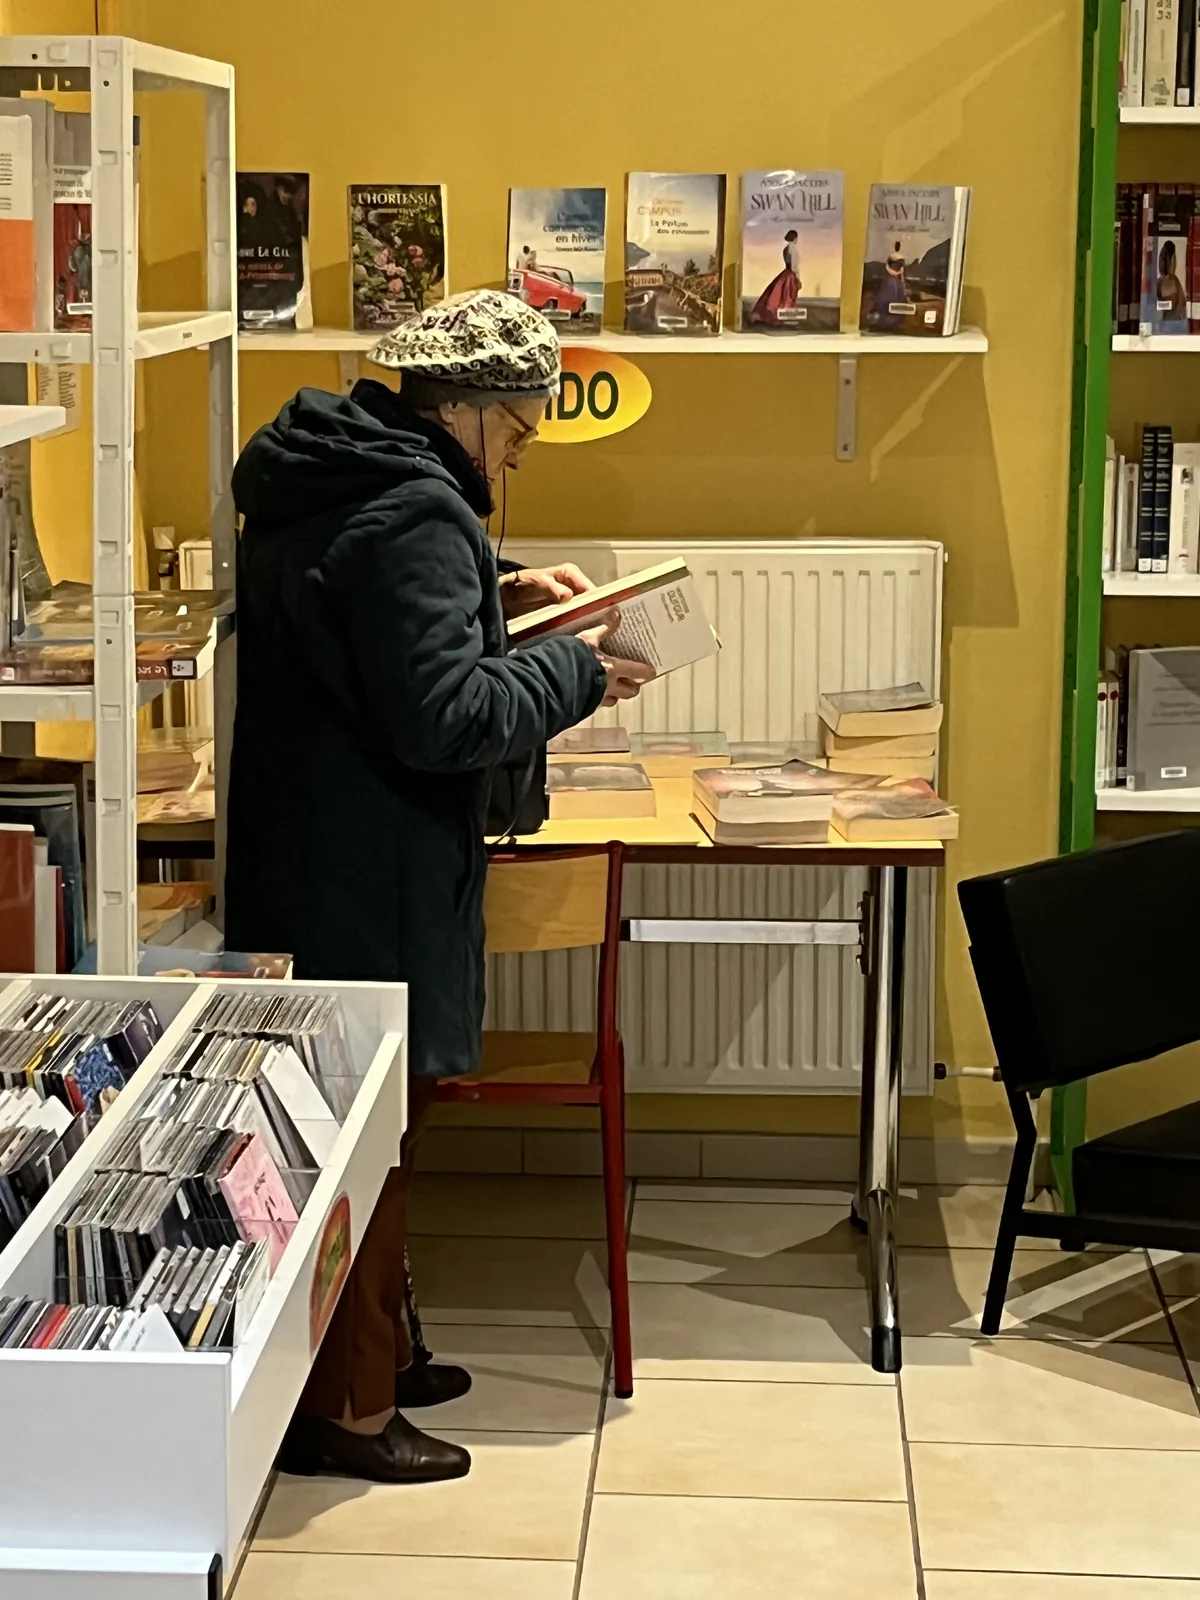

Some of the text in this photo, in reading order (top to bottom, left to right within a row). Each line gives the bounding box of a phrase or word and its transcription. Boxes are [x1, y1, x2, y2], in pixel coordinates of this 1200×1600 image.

[751, 189, 837, 216] SWAN HILL
[873, 200, 945, 224] SWAN HILL
[555, 233, 597, 244] en hiver
